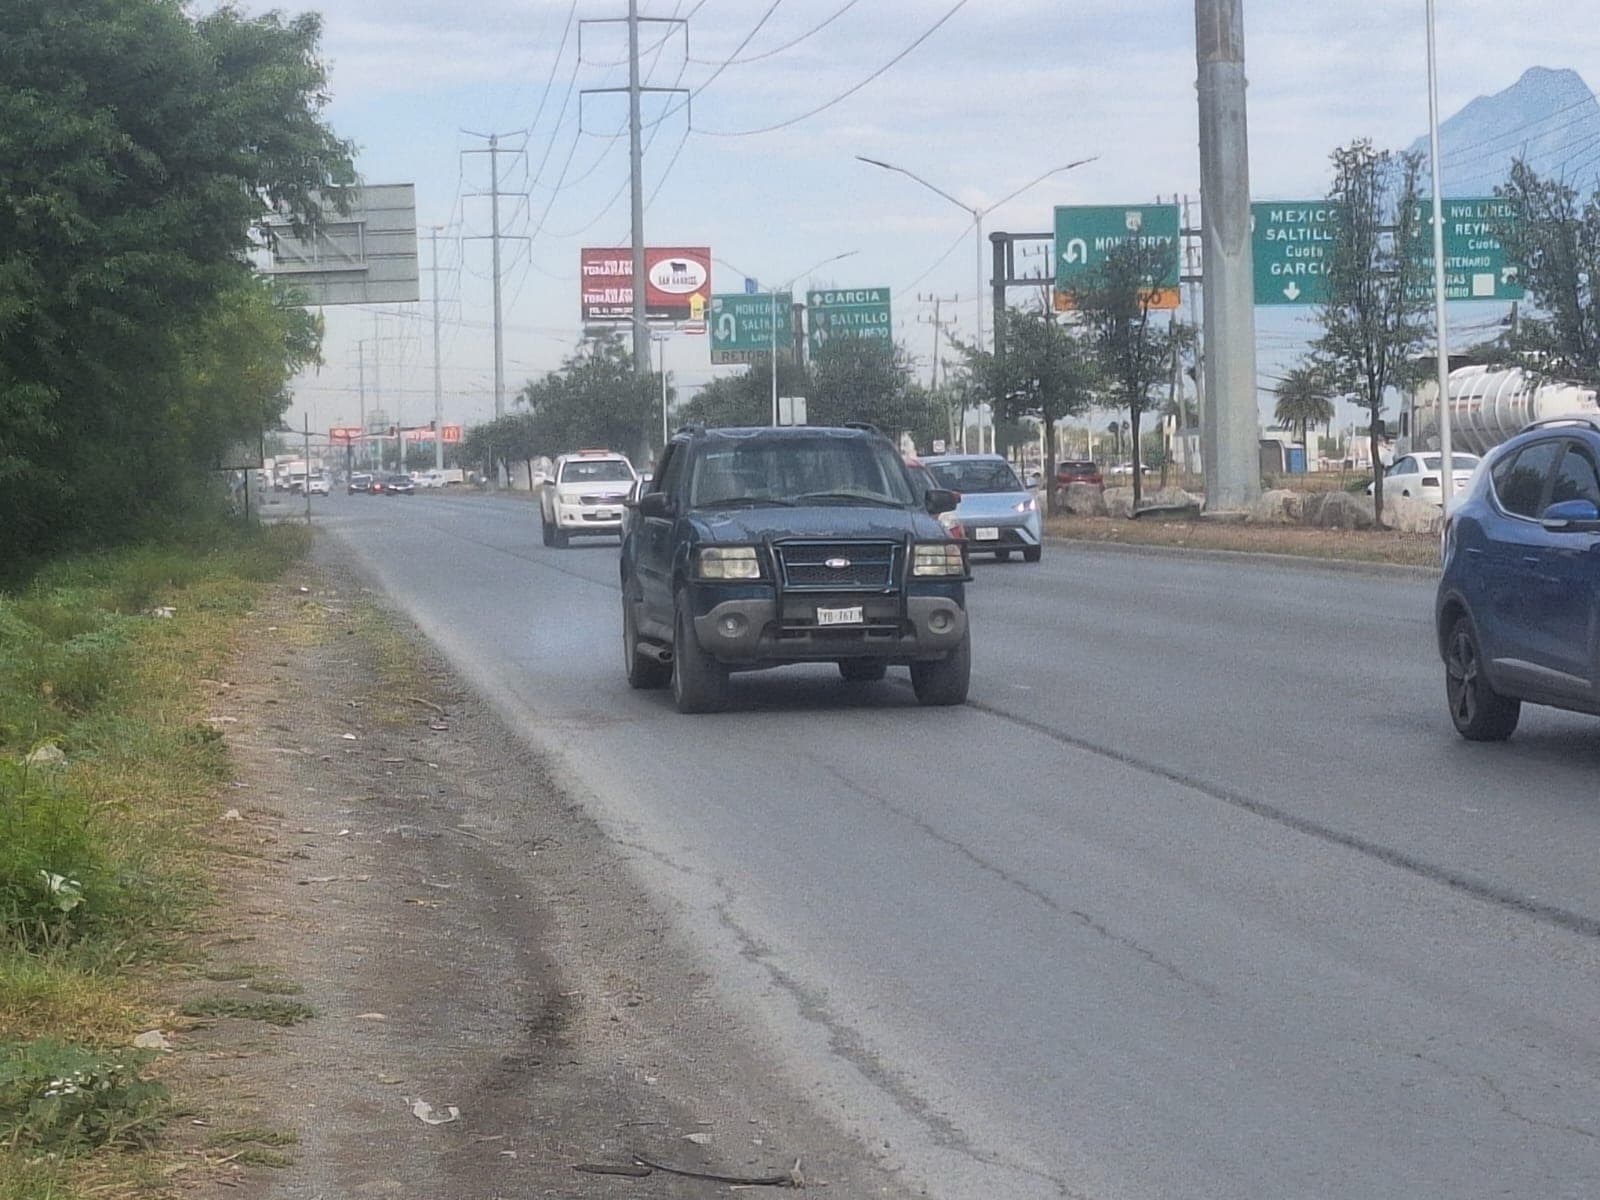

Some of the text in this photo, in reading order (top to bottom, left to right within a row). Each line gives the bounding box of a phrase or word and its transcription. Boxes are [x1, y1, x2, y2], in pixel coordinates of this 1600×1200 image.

[1265, 227, 1340, 241] SALTILL
[1095, 235, 1172, 252] MONERREY
[824, 290, 880, 304] GARCIA
[735, 303, 789, 315] MONTEREY
[831, 312, 888, 325] SALTILLO
